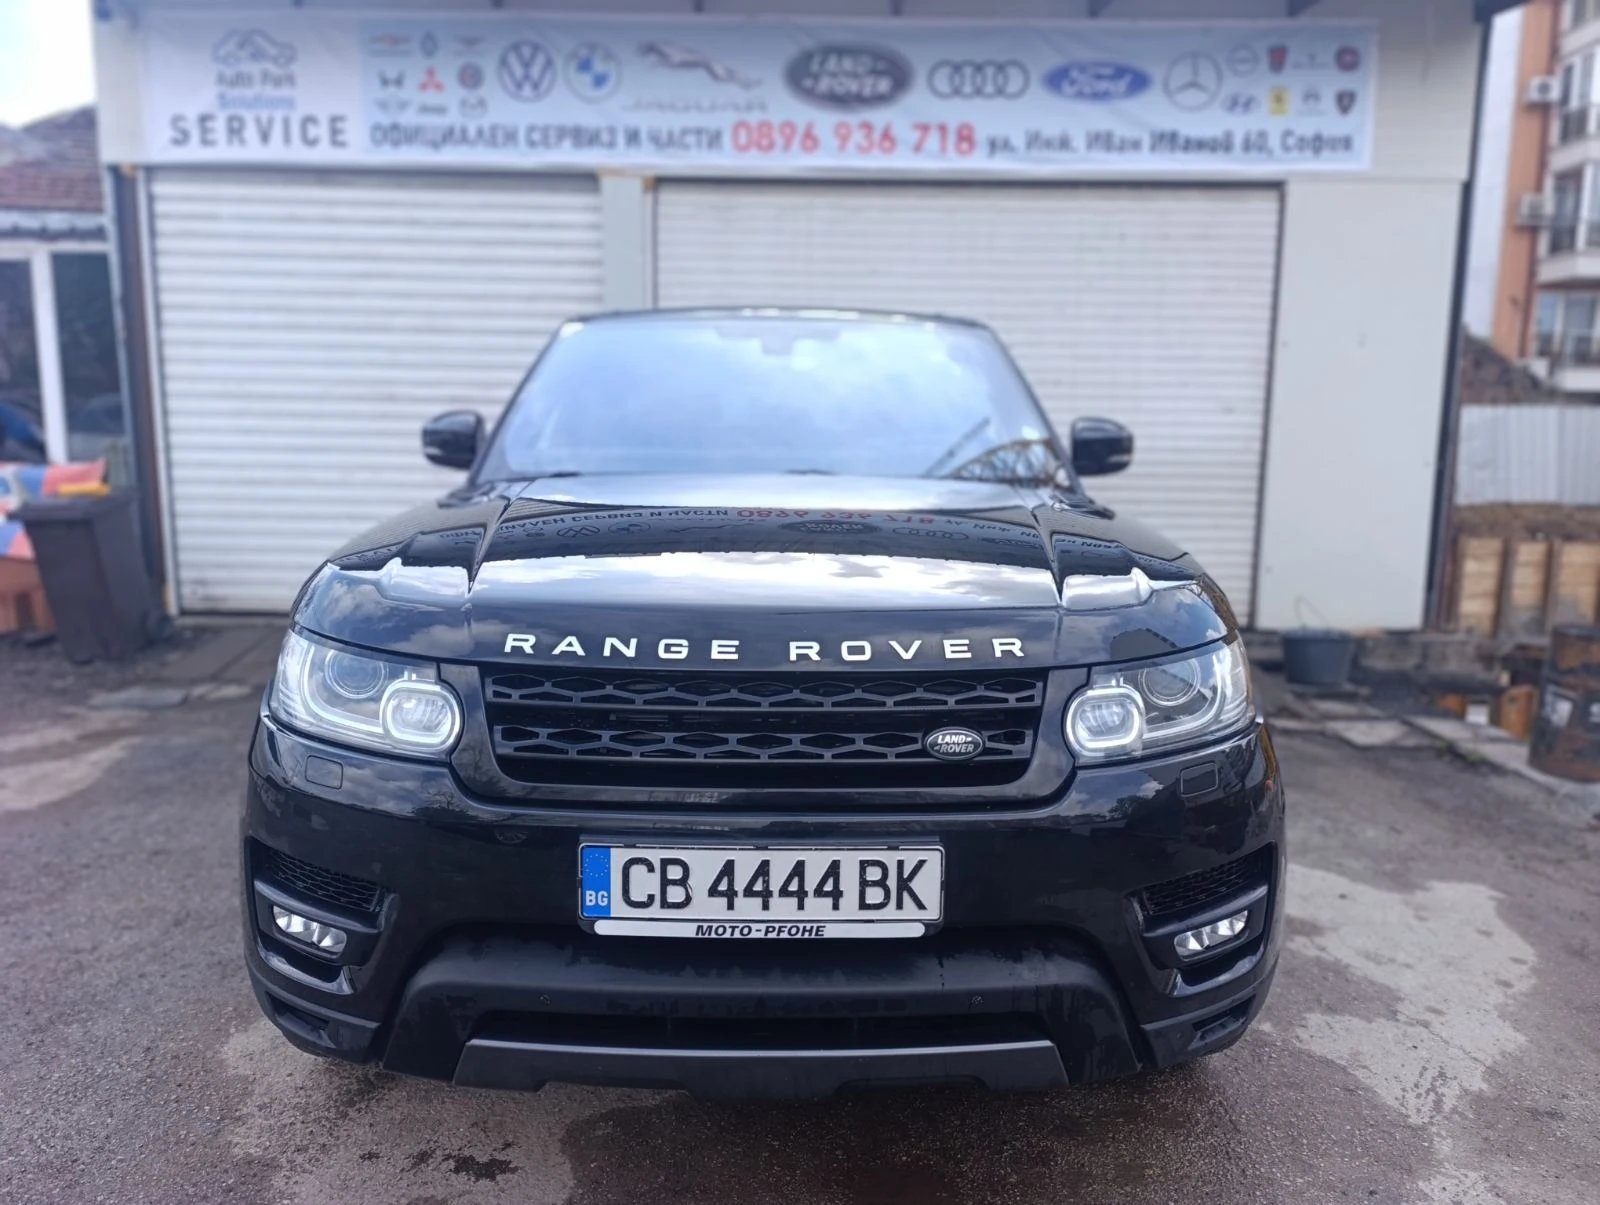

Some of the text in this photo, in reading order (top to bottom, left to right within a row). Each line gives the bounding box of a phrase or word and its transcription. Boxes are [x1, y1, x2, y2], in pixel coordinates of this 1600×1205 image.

[815, 75, 894, 98] ROVER
[1060, 67, 1138, 95] Ford
[169, 113, 350, 148] SERVICE
[369, 122, 519, 151] ОФИЦИАЛЕН
[525, 123, 617, 150] СЕРВИЗ
[624, 125, 641, 150] И
[647, 126, 723, 150] ЧАСТИ
[731, 119, 820, 155] 0896
[833, 122, 897, 155] 936
[911, 123, 976, 156] 718
[504, 633, 1025, 661] RANGE ROVER
[937, 734, 966, 744] LAND
[939, 743, 975, 753] ROVER
[621, 856, 928, 912] CB 4444 BK
[585, 890, 608, 907] BG
[695, 924, 826, 938] MOTO-PFOHE
